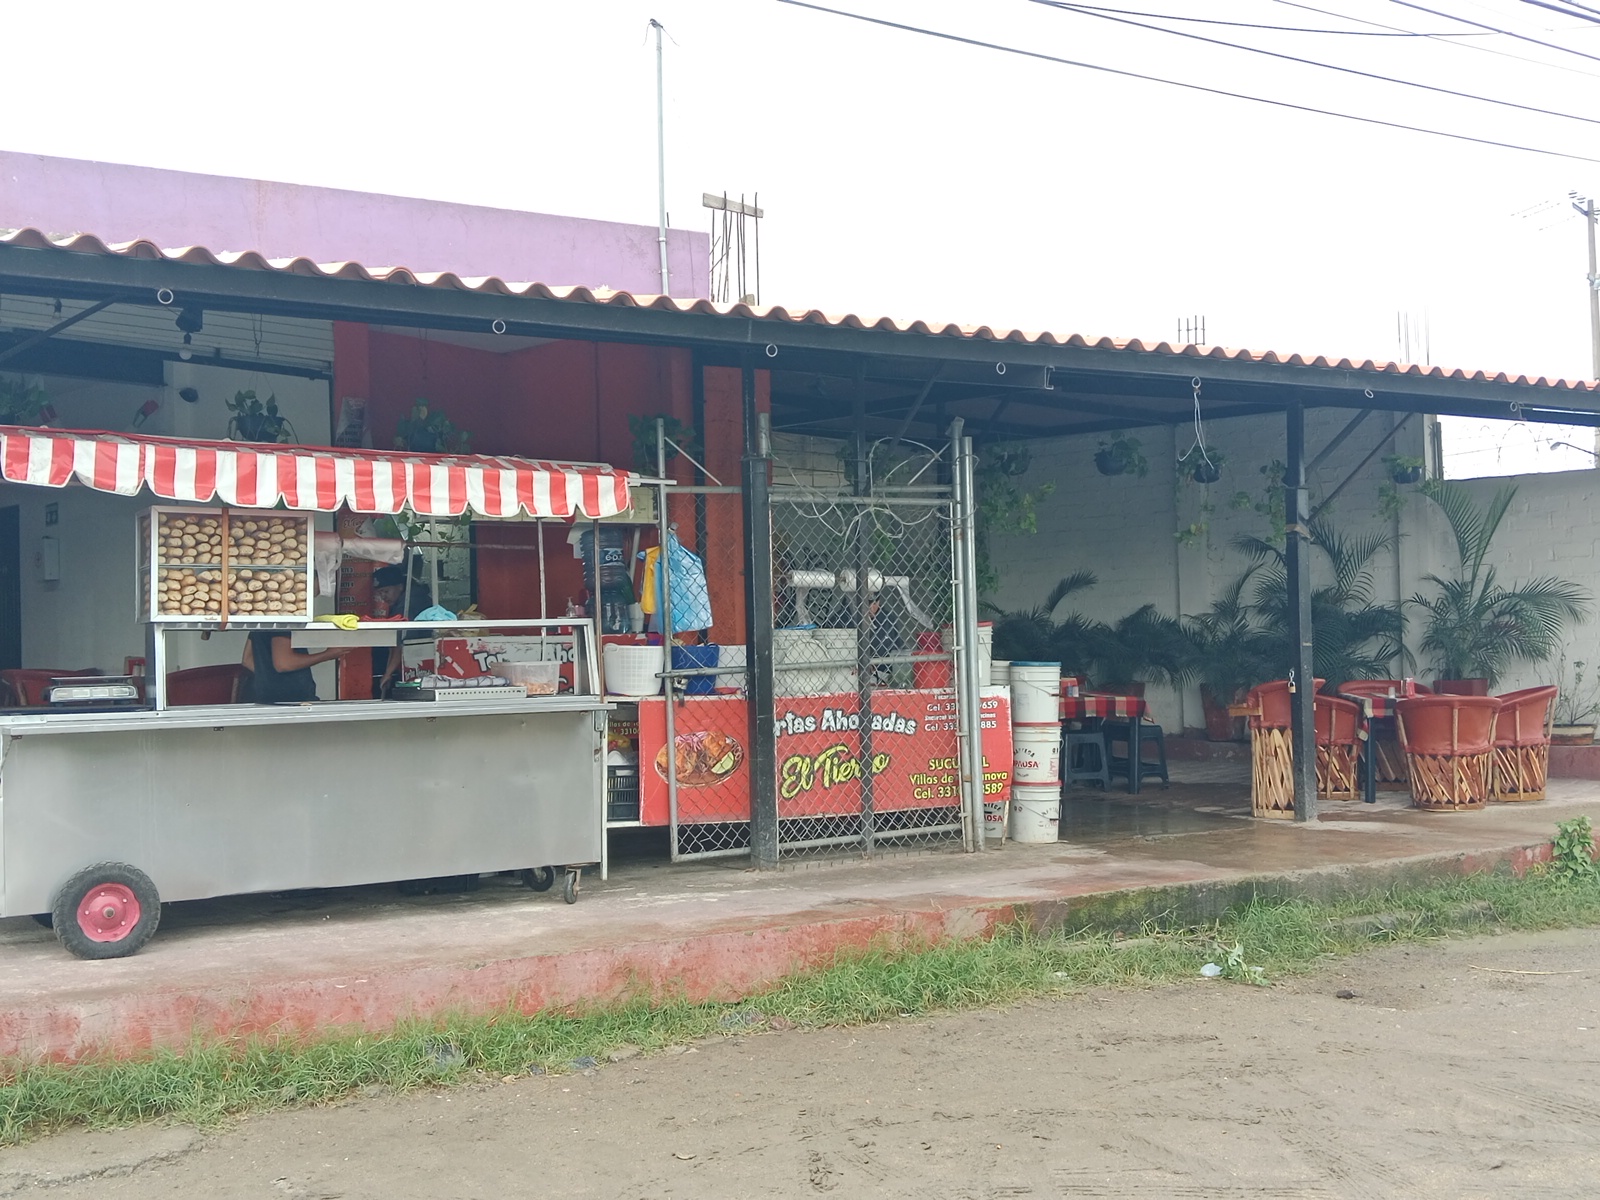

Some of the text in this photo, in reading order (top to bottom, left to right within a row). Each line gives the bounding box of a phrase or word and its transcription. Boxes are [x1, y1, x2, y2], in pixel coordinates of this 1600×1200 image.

[773, 709, 918, 737] rtas Ahoadas
[928, 756, 989, 771] SUCUL
[780, 744, 891, 799] El Tiero
[909, 773, 938, 785] Villas
[941, 772, 954, 784] de
[913, 787, 935, 799] Cel.
